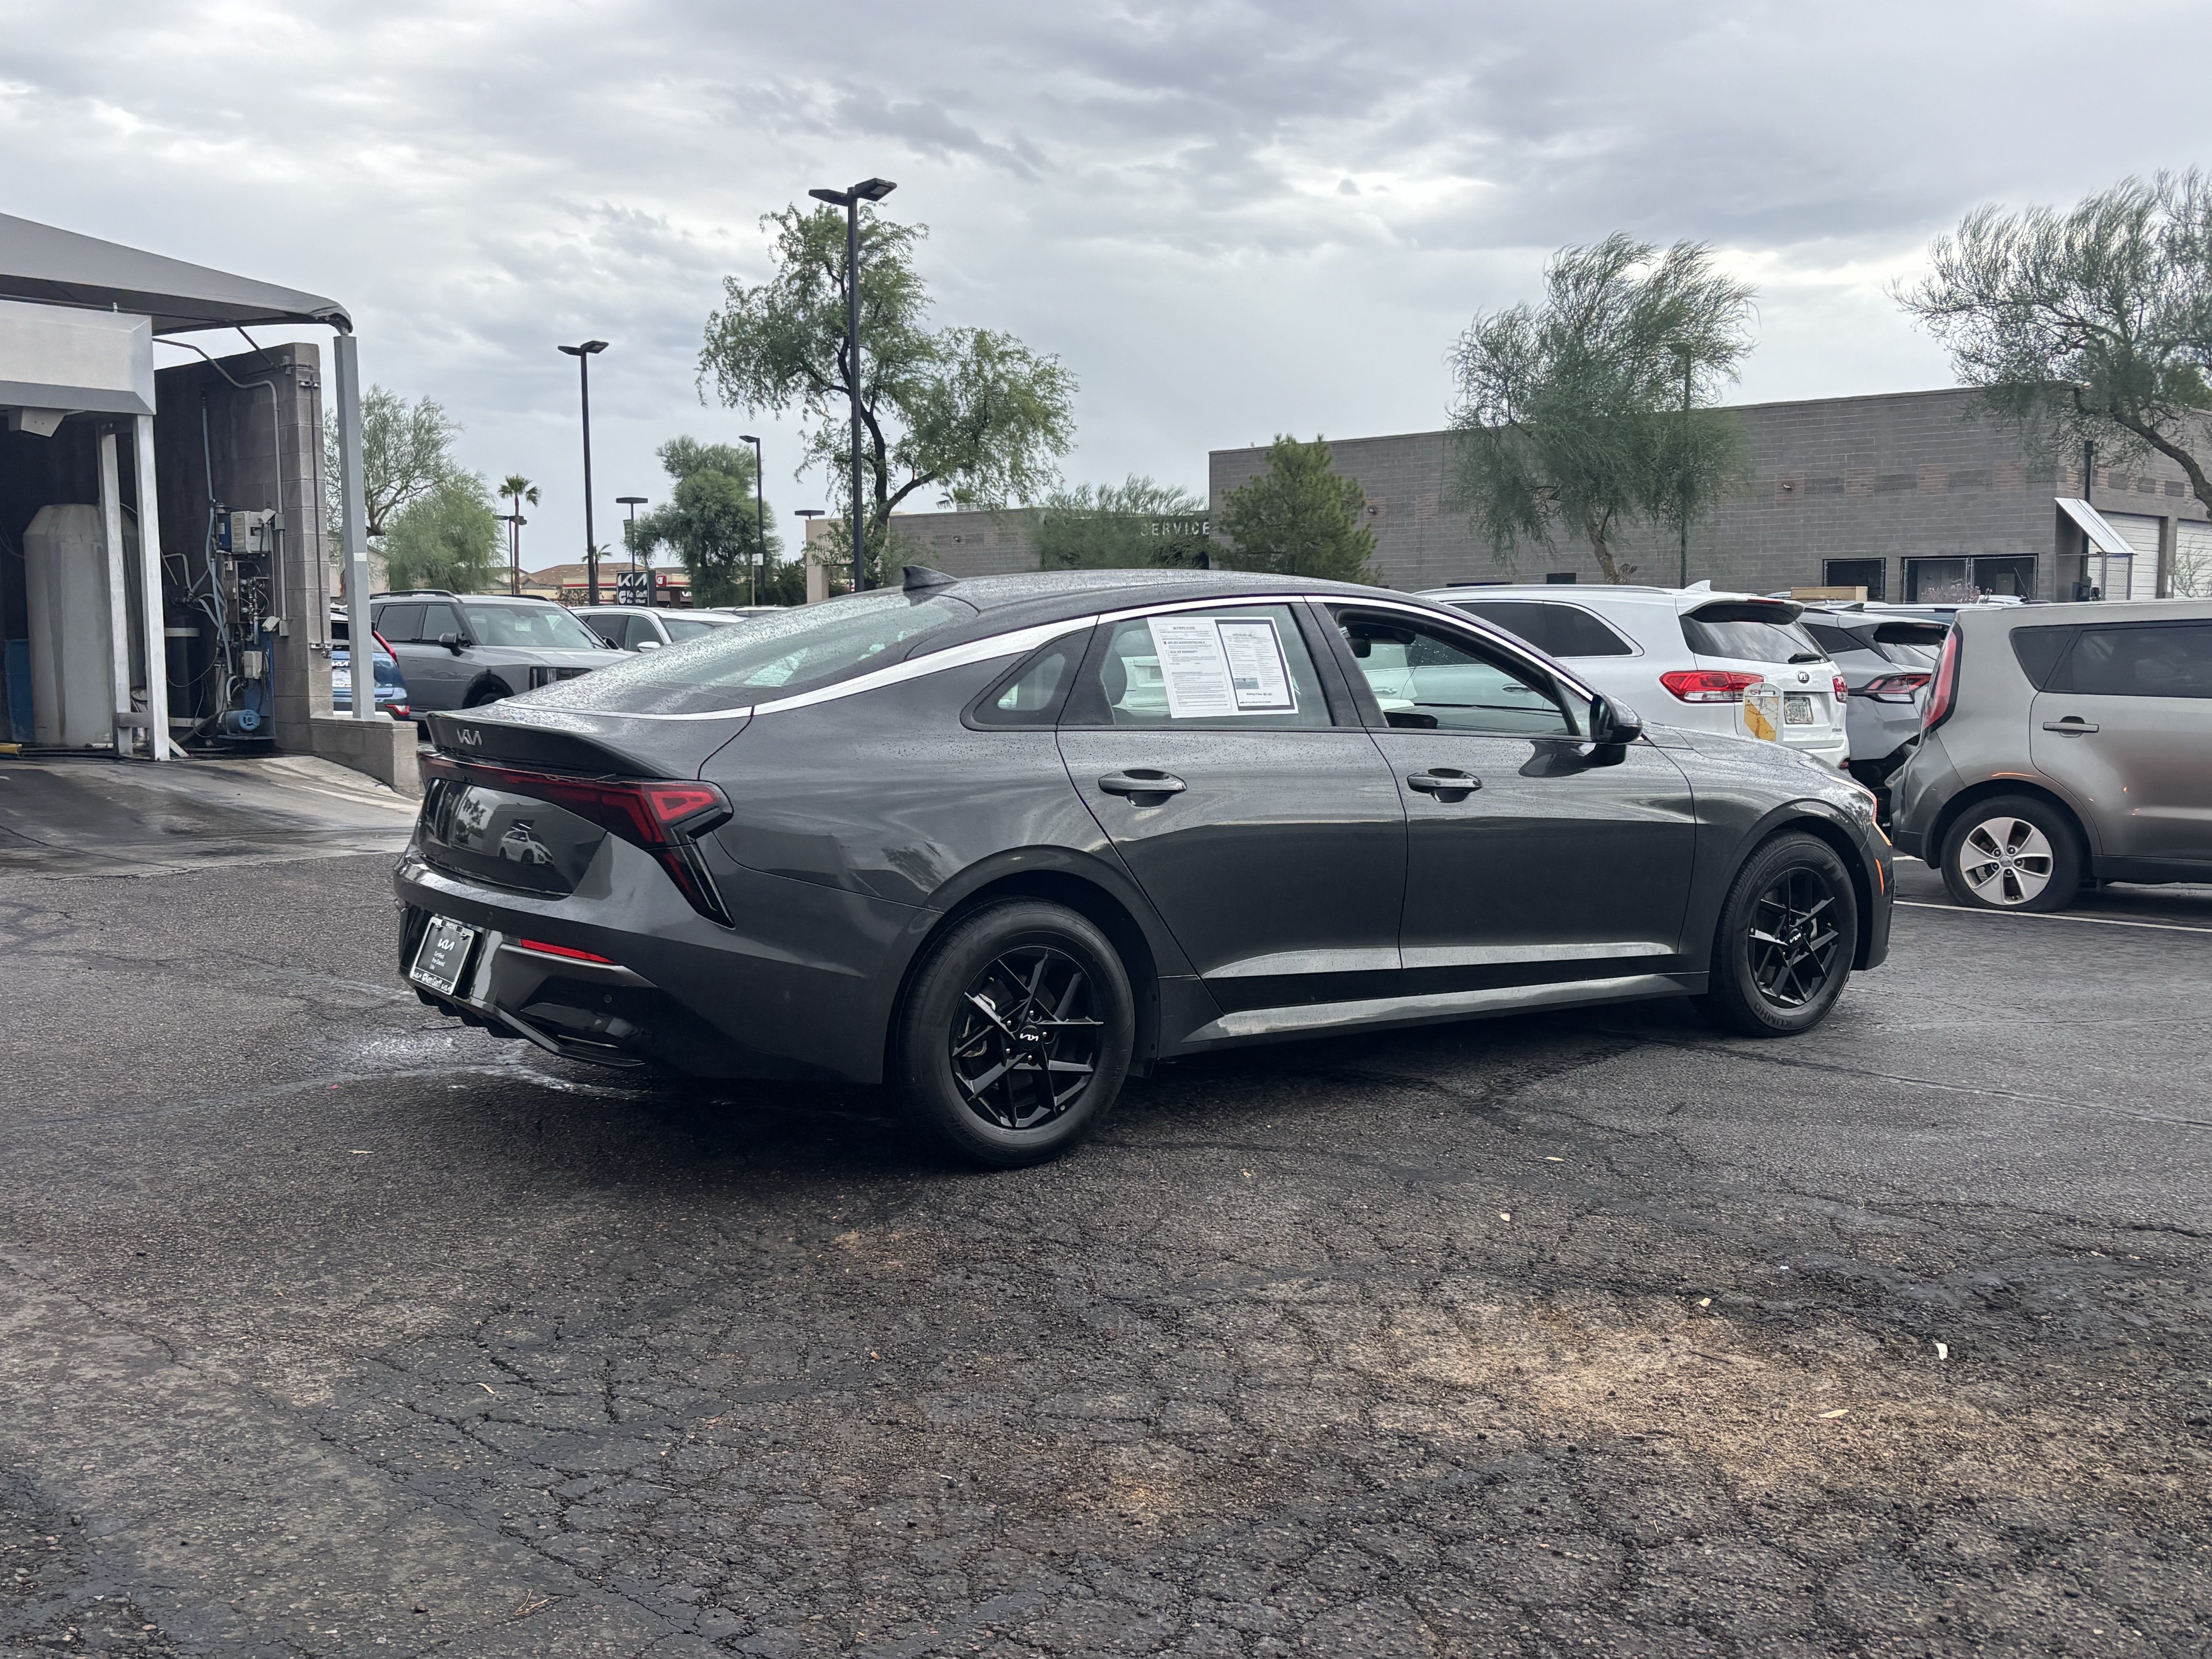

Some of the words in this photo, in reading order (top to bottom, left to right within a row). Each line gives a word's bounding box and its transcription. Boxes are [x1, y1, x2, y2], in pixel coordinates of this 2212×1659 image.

[618, 573, 647, 586] KIA
[457, 728, 482, 745] KIA
[437, 938, 455, 951] KIA
[1754, 1002, 1792, 1027] KUMHO
